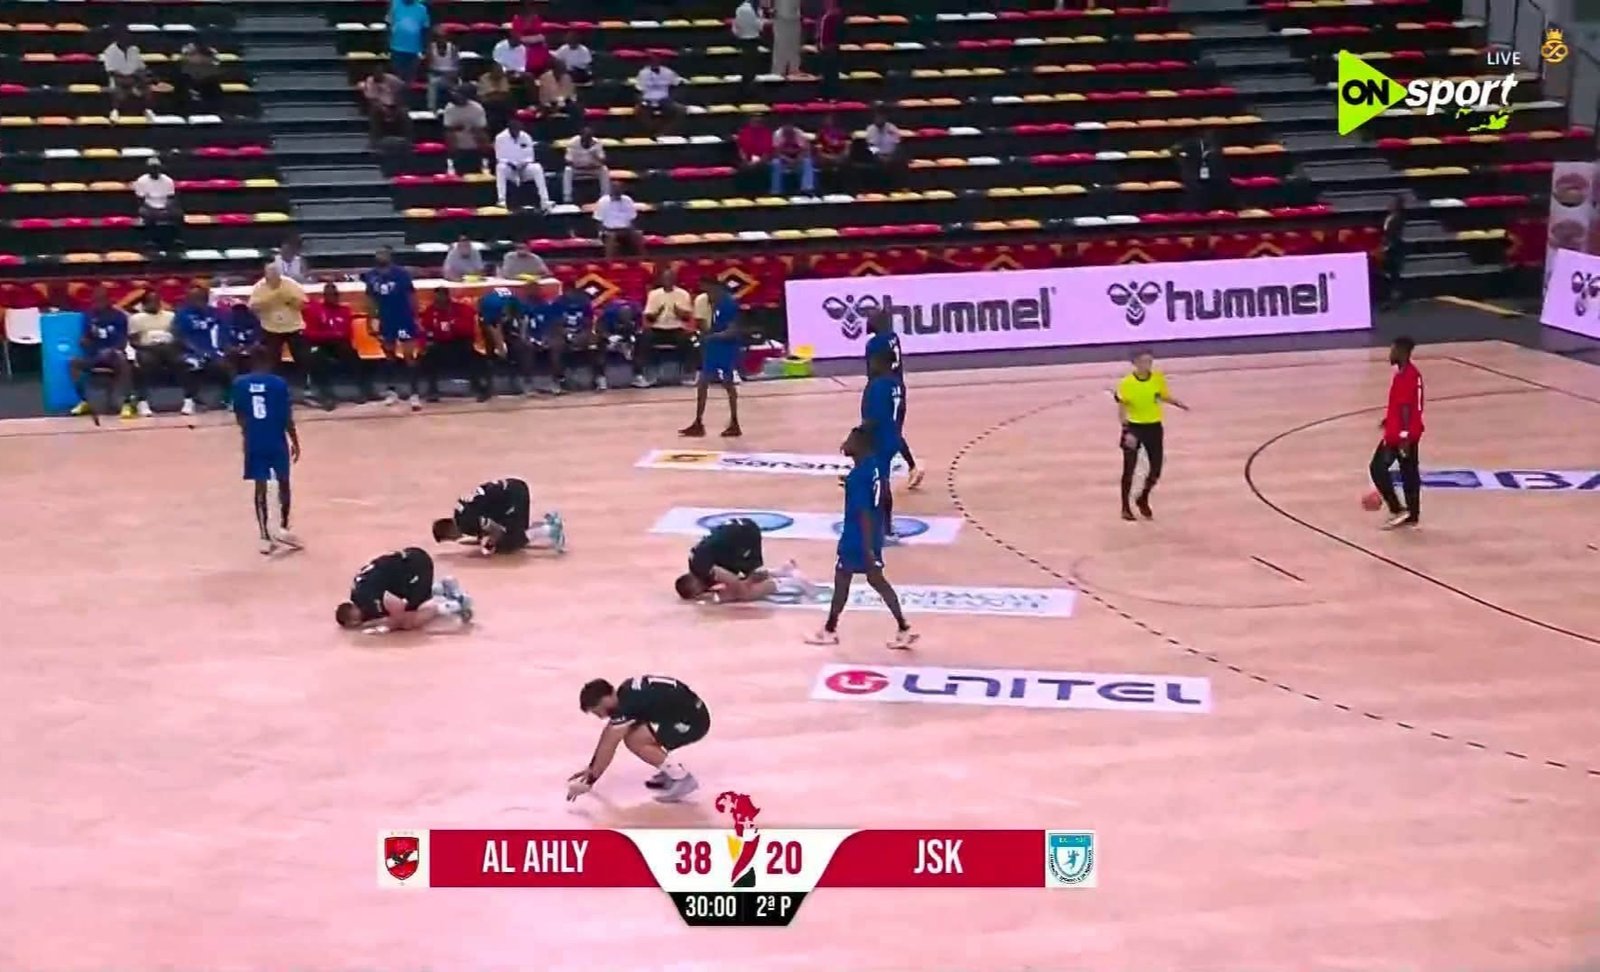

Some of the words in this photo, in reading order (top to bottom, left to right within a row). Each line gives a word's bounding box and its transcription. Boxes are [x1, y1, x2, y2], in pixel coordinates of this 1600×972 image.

[883, 287, 1051, 335] hummel
[1165, 273, 1329, 322] hummel
[252, 395, 267, 419] 6
